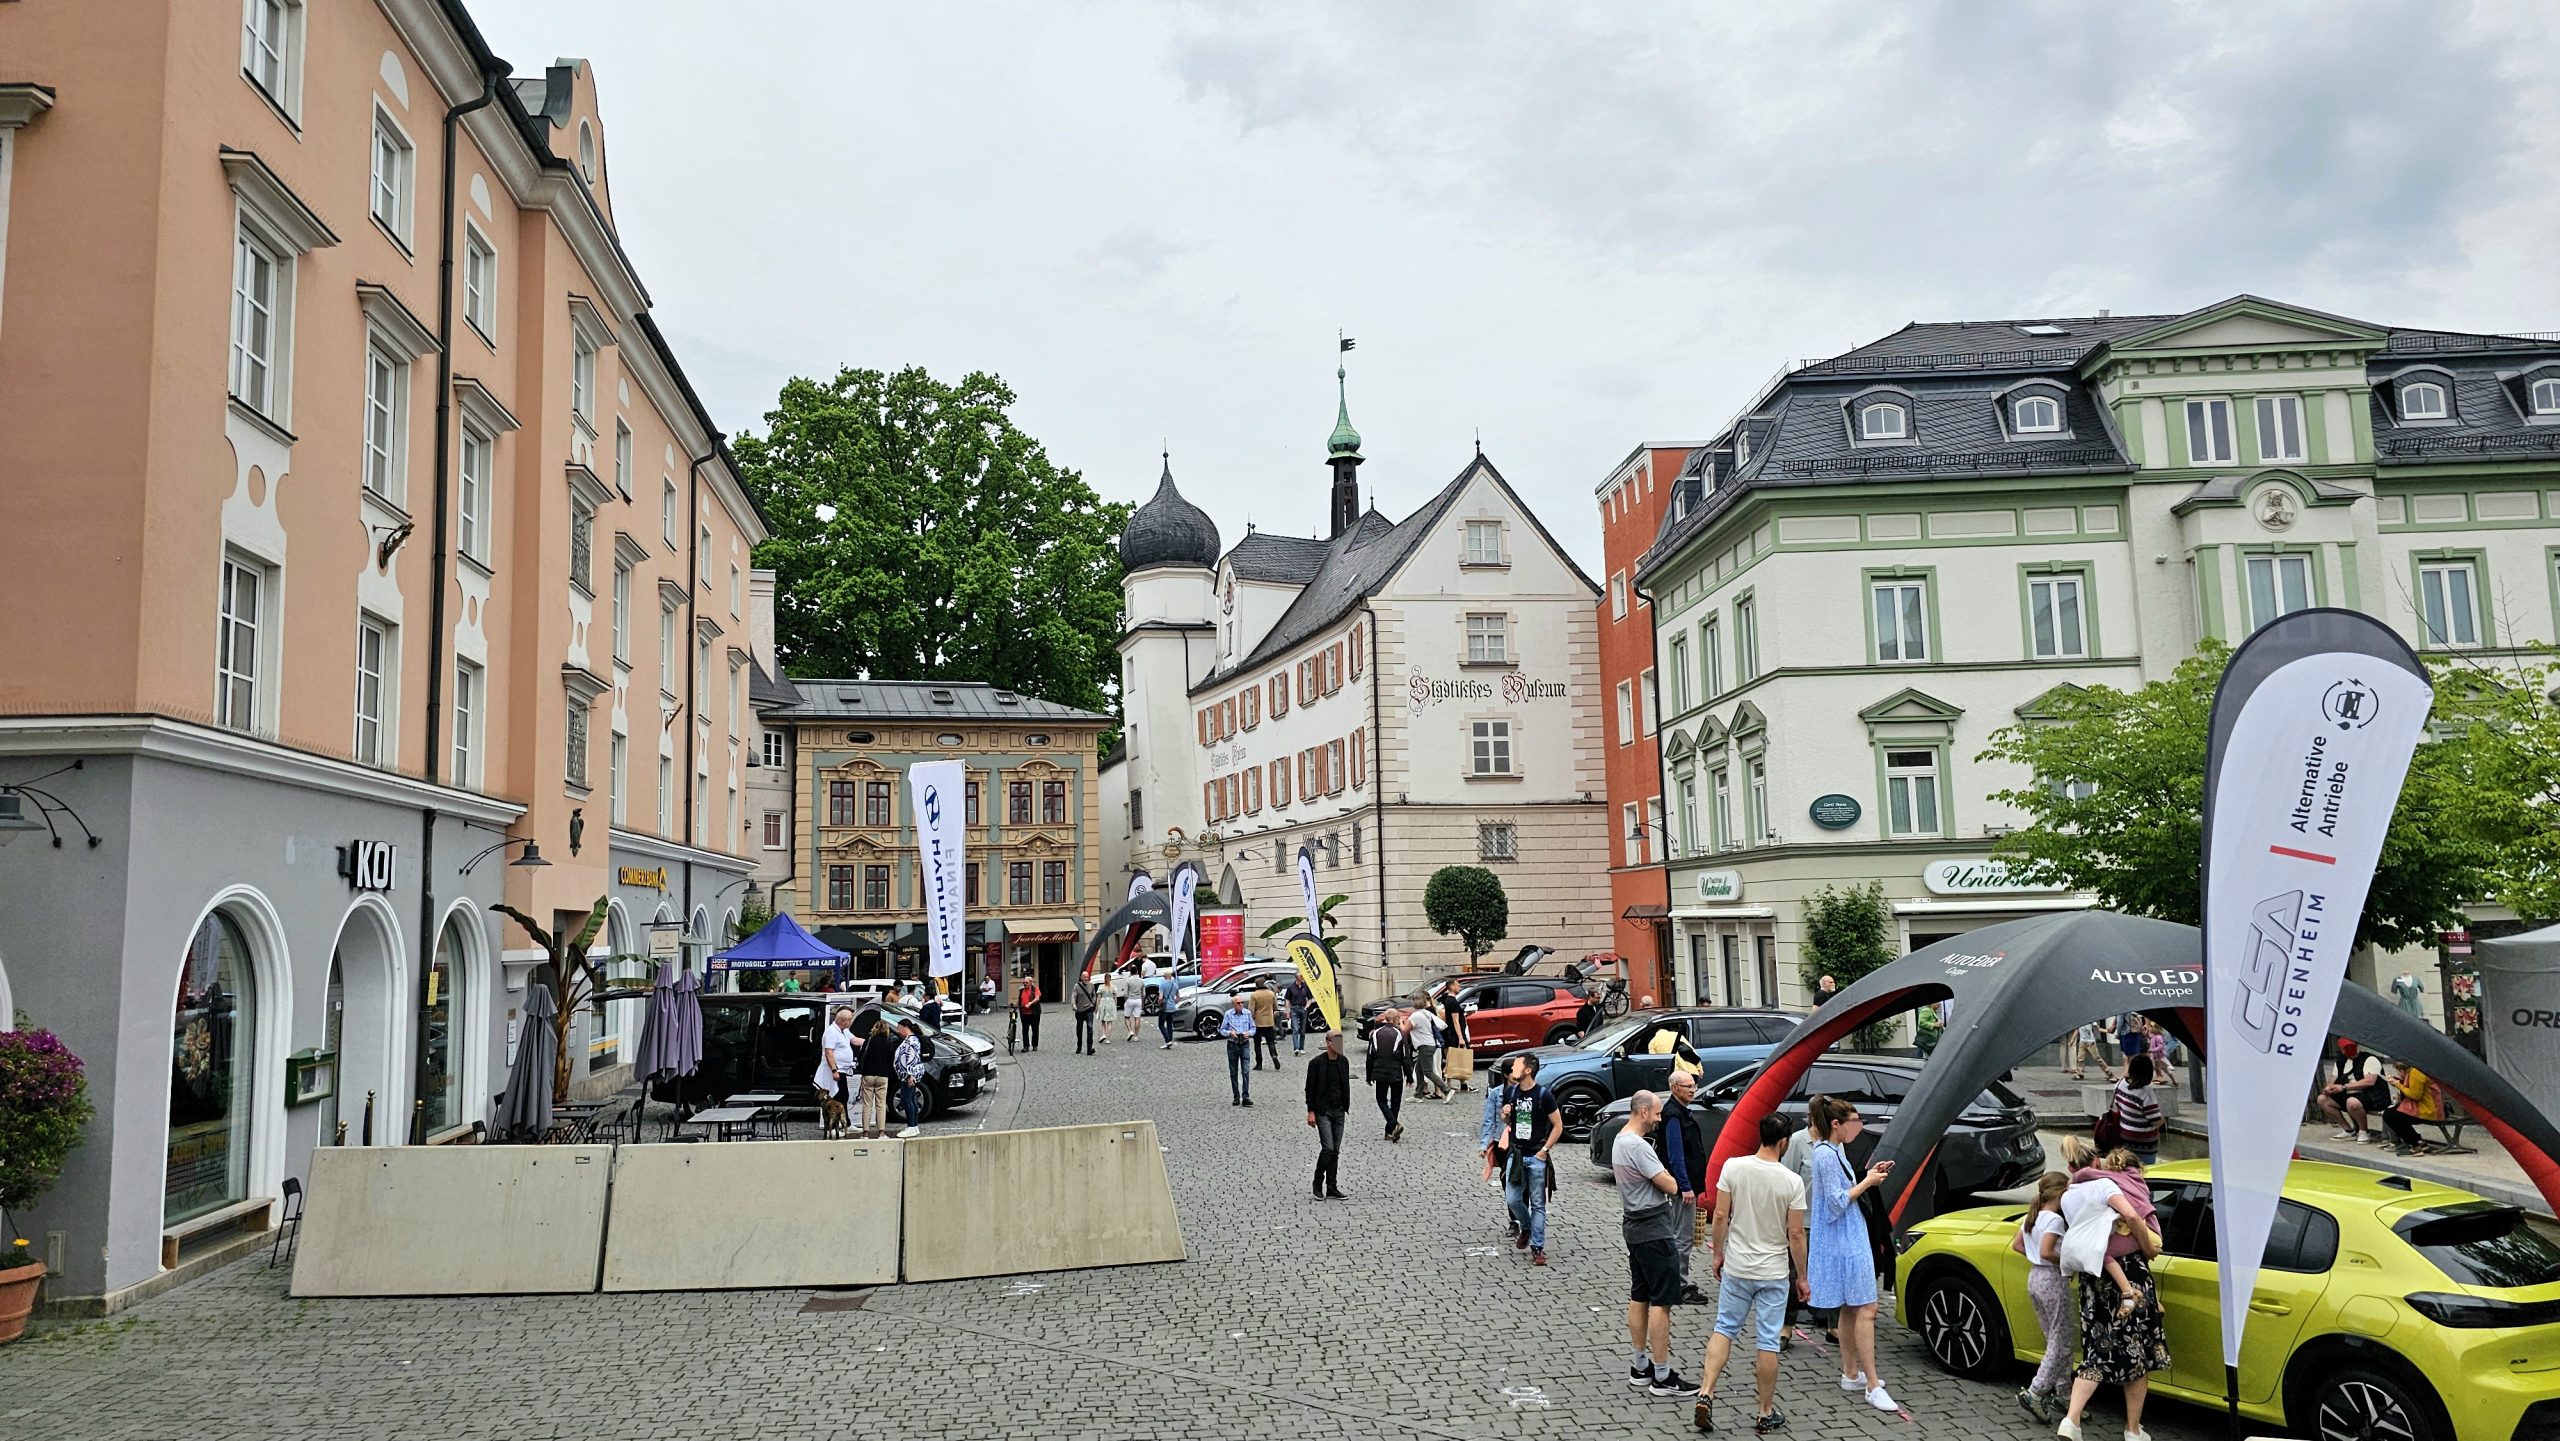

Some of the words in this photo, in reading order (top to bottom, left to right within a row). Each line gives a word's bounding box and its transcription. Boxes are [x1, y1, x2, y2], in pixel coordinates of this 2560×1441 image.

[1501, 672, 1567, 705] Museum
[2290, 736, 2327, 833] Alternative
[2317, 761, 2348, 837] Antriebe
[355, 840, 397, 890] KOI
[618, 867, 660, 888] COMMERZBANK
[731, 960, 767, 968] MOTOROILS
[771, 960, 803, 968] ADDITIVES
[2231, 889, 2304, 1054] CSA
[2277, 894, 2326, 1056] ROSENHEIM
[2139, 986, 2193, 998] Gruppe
